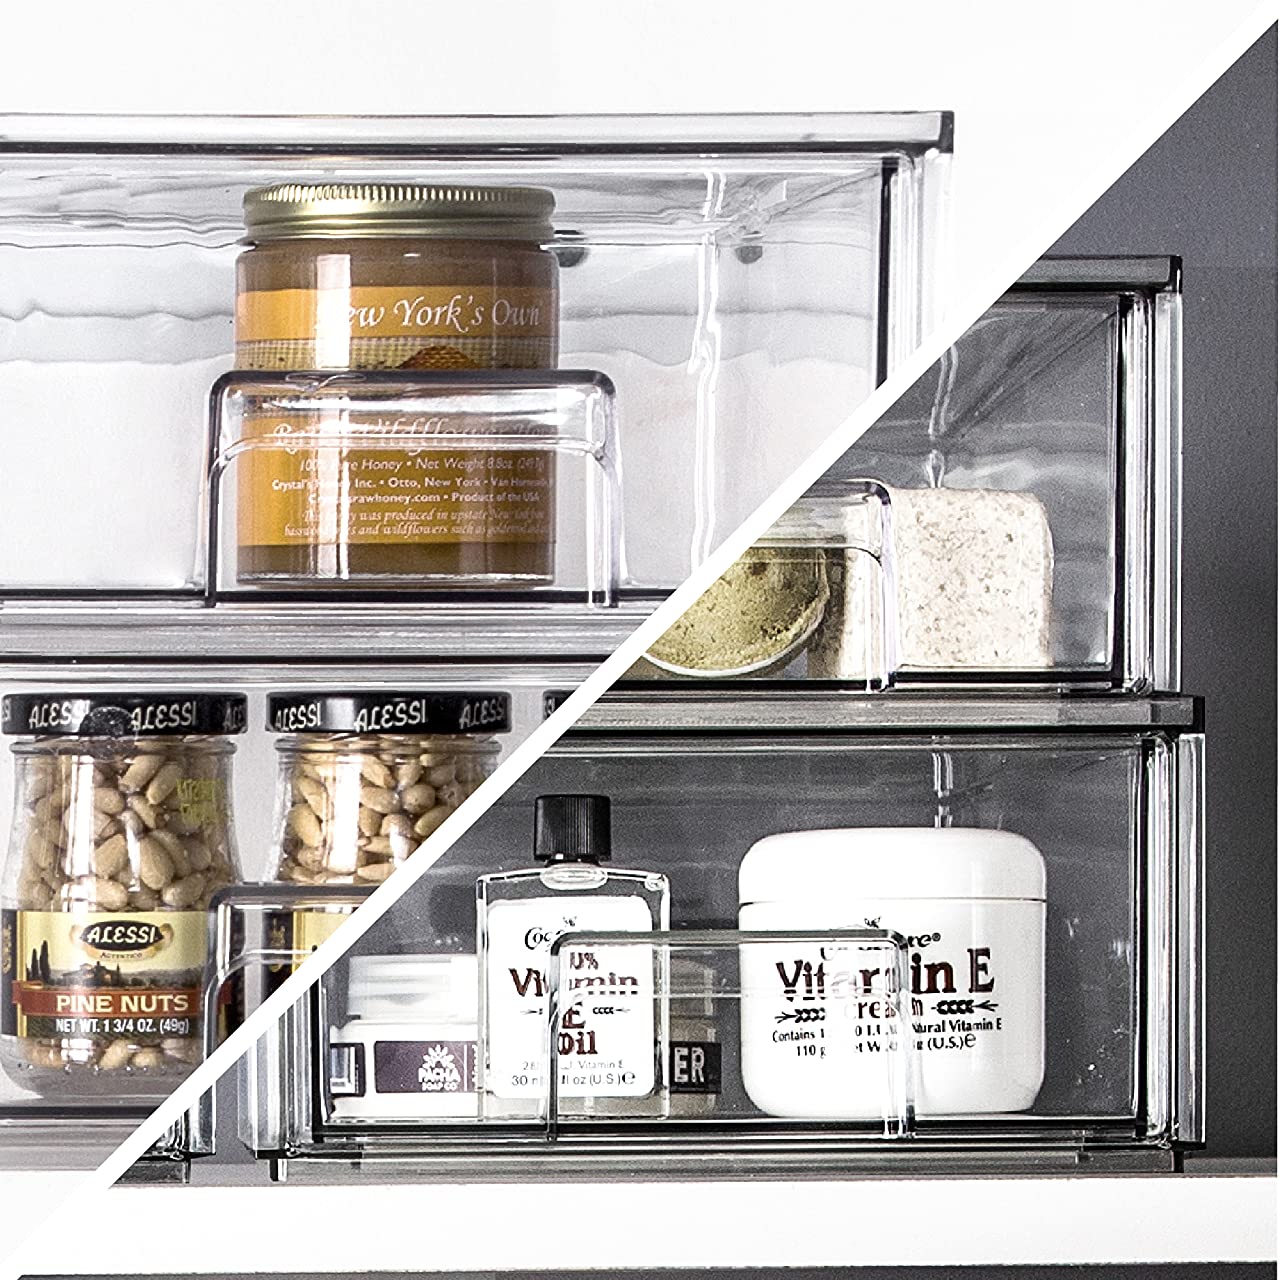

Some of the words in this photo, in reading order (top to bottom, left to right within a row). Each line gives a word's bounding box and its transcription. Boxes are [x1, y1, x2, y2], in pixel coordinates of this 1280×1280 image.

[392, 295, 485, 333] York's
[491, 298, 539, 327] Own
[361, 458, 403, 473] Honey
[415, 458, 439, 470] Net
[354, 479, 378, 489] Inc.
[387, 477, 421, 489] Otto,
[424, 476, 452, 488] New
[451, 491, 494, 502] Product
[383, 507, 434, 525] produced
[28, 699, 92, 730] ALESSI
[130, 701, 197, 731] ALESSI
[275, 702, 322, 732] ALESSI
[353, 699, 426, 733] ALESSI
[86, 925, 156, 944] ALESSI
[775, 952, 958, 1000] Vitmin
[966, 946, 995, 994] E
[56, 993, 114, 1014] PINE
[120, 993, 190, 1014] NUTS
[846, 996, 925, 1021] ream
[561, 1001, 587, 1030] E
[55, 1018, 76, 1033] NET
[78, 1018, 101, 1033] WT.
[103, 1018, 110, 1033] 1
[113, 1018, 134, 1033] 3/4
[136, 1018, 157, 1033] OZ.
[159, 1018, 190, 1035] (49g)
[771, 1027, 816, 1044] Contains
[948, 1017, 994, 1033] Vitamin
[796, 1044, 817, 1057] 110
[511, 1074, 529, 1087] 30
[573, 1076, 587, 1086] oz
